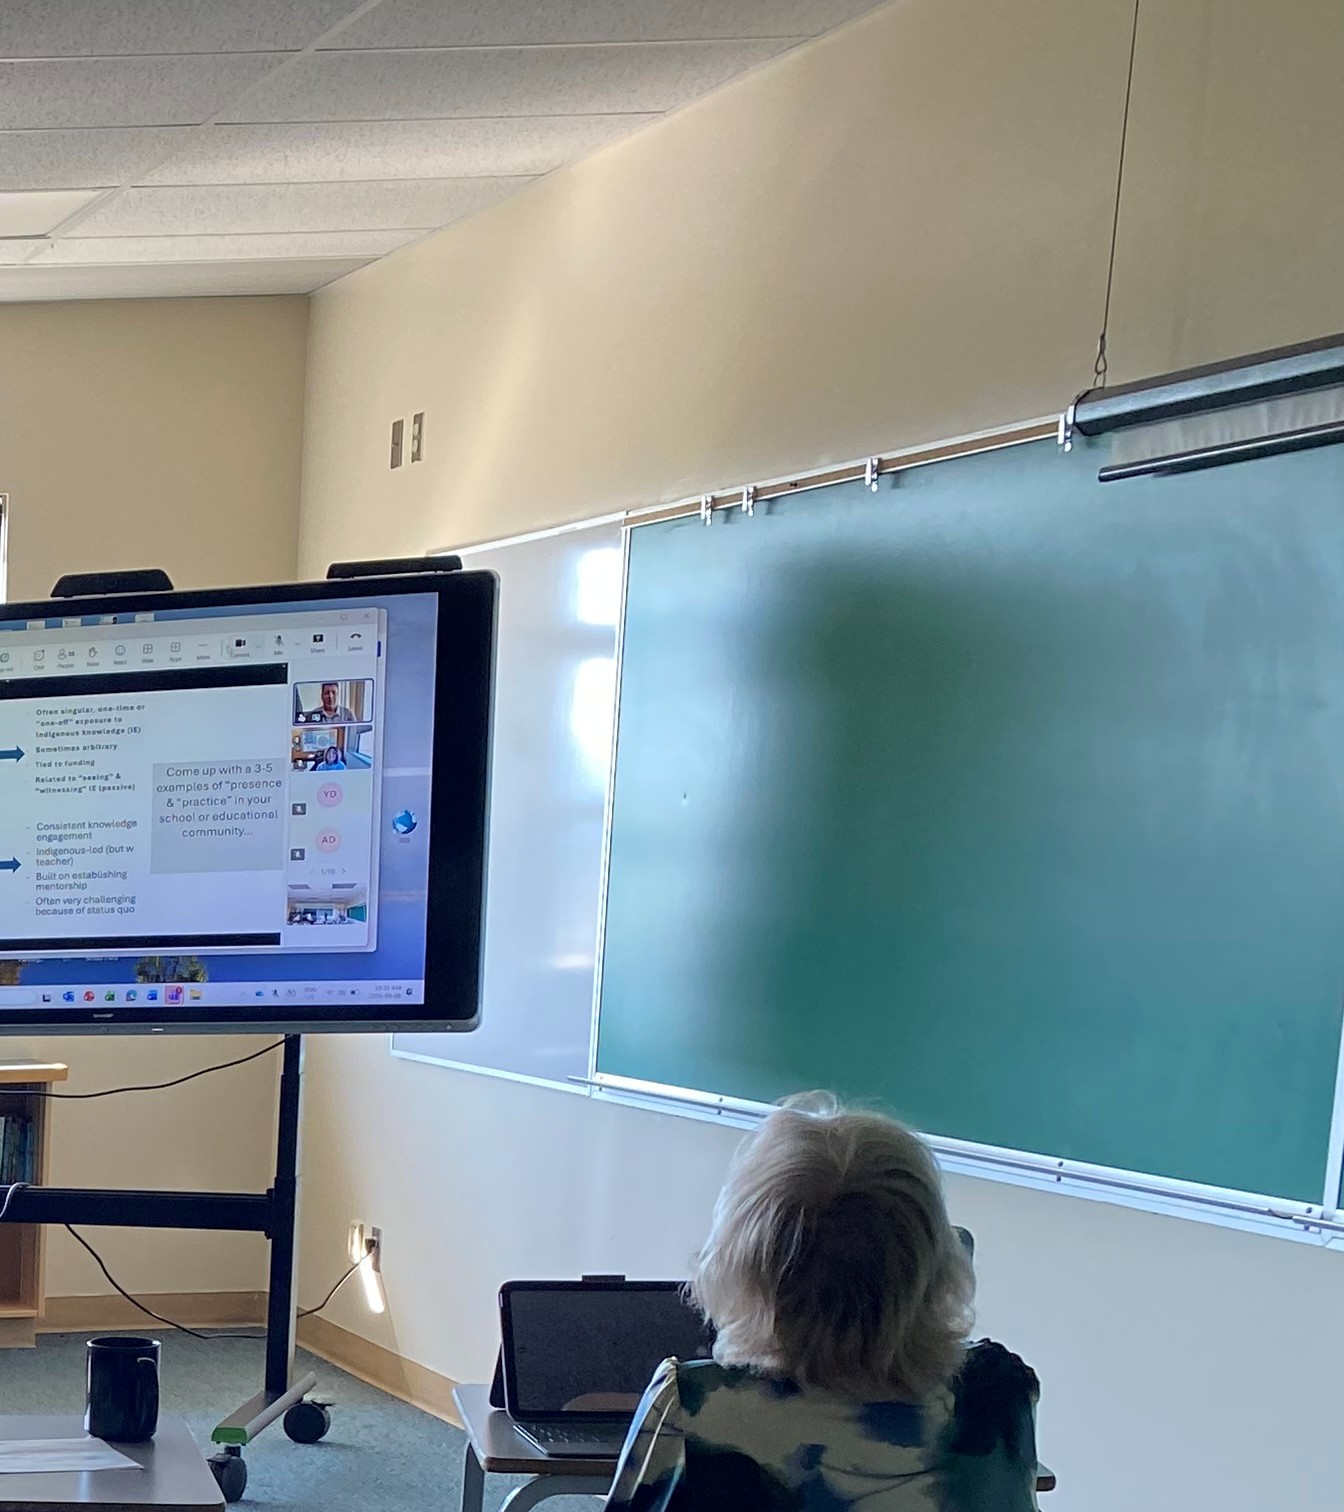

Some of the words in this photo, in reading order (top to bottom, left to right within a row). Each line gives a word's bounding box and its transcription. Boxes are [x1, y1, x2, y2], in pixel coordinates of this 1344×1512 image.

[36, 708, 59, 716] Often
[97, 705, 135, 713] one-time
[75, 717, 112, 726] exposure
[35, 730, 80, 739] Indigenous
[81, 728, 125, 736] knowledge
[127, 727, 141, 735] (IE)
[35, 745, 80, 754] Sometimes
[82, 744, 118, 753] arbitrary
[54, 760, 62, 768] to
[64, 759, 95, 769] funding
[166, 766, 200, 777] Come
[202, 767, 217, 778] up
[218, 764, 243, 775] with
[245, 766, 252, 774] a
[254, 763, 273, 773] 3-5
[35, 775, 66, 784] Related
[98, 784, 136, 792] (passive)
[156, 781, 210, 793] examples
[212, 779, 223, 790] of
[323, 790, 337, 799] YD
[166, 798, 175, 807] &
[234, 795, 243, 805] in
[245, 796, 271, 806] your
[158, 812, 196, 824] school
[198, 814, 210, 822] or
[212, 810, 278, 822] educational
[36, 822, 86, 831] Consistent
[87, 819, 138, 830] knowledge
[36, 831, 93, 842] engagement
[321, 835, 336, 844] AD
[36, 845, 104, 856] Indigenous-led
[105, 844, 124, 854] (but
[36, 857, 74, 867] teacher)
[35, 872, 56, 881] Built
[58, 872, 70, 880] on
[72, 869, 128, 881] establishing
[35, 882, 88, 892] mentorship
[35, 896, 61, 906] Often
[63, 897, 81, 906] very
[83, 894, 137, 906] challenging
[35, 906, 74, 916] because
[75, 906, 85, 915] of
[86, 906, 116, 915] status
[117, 906, 135, 915] quo
